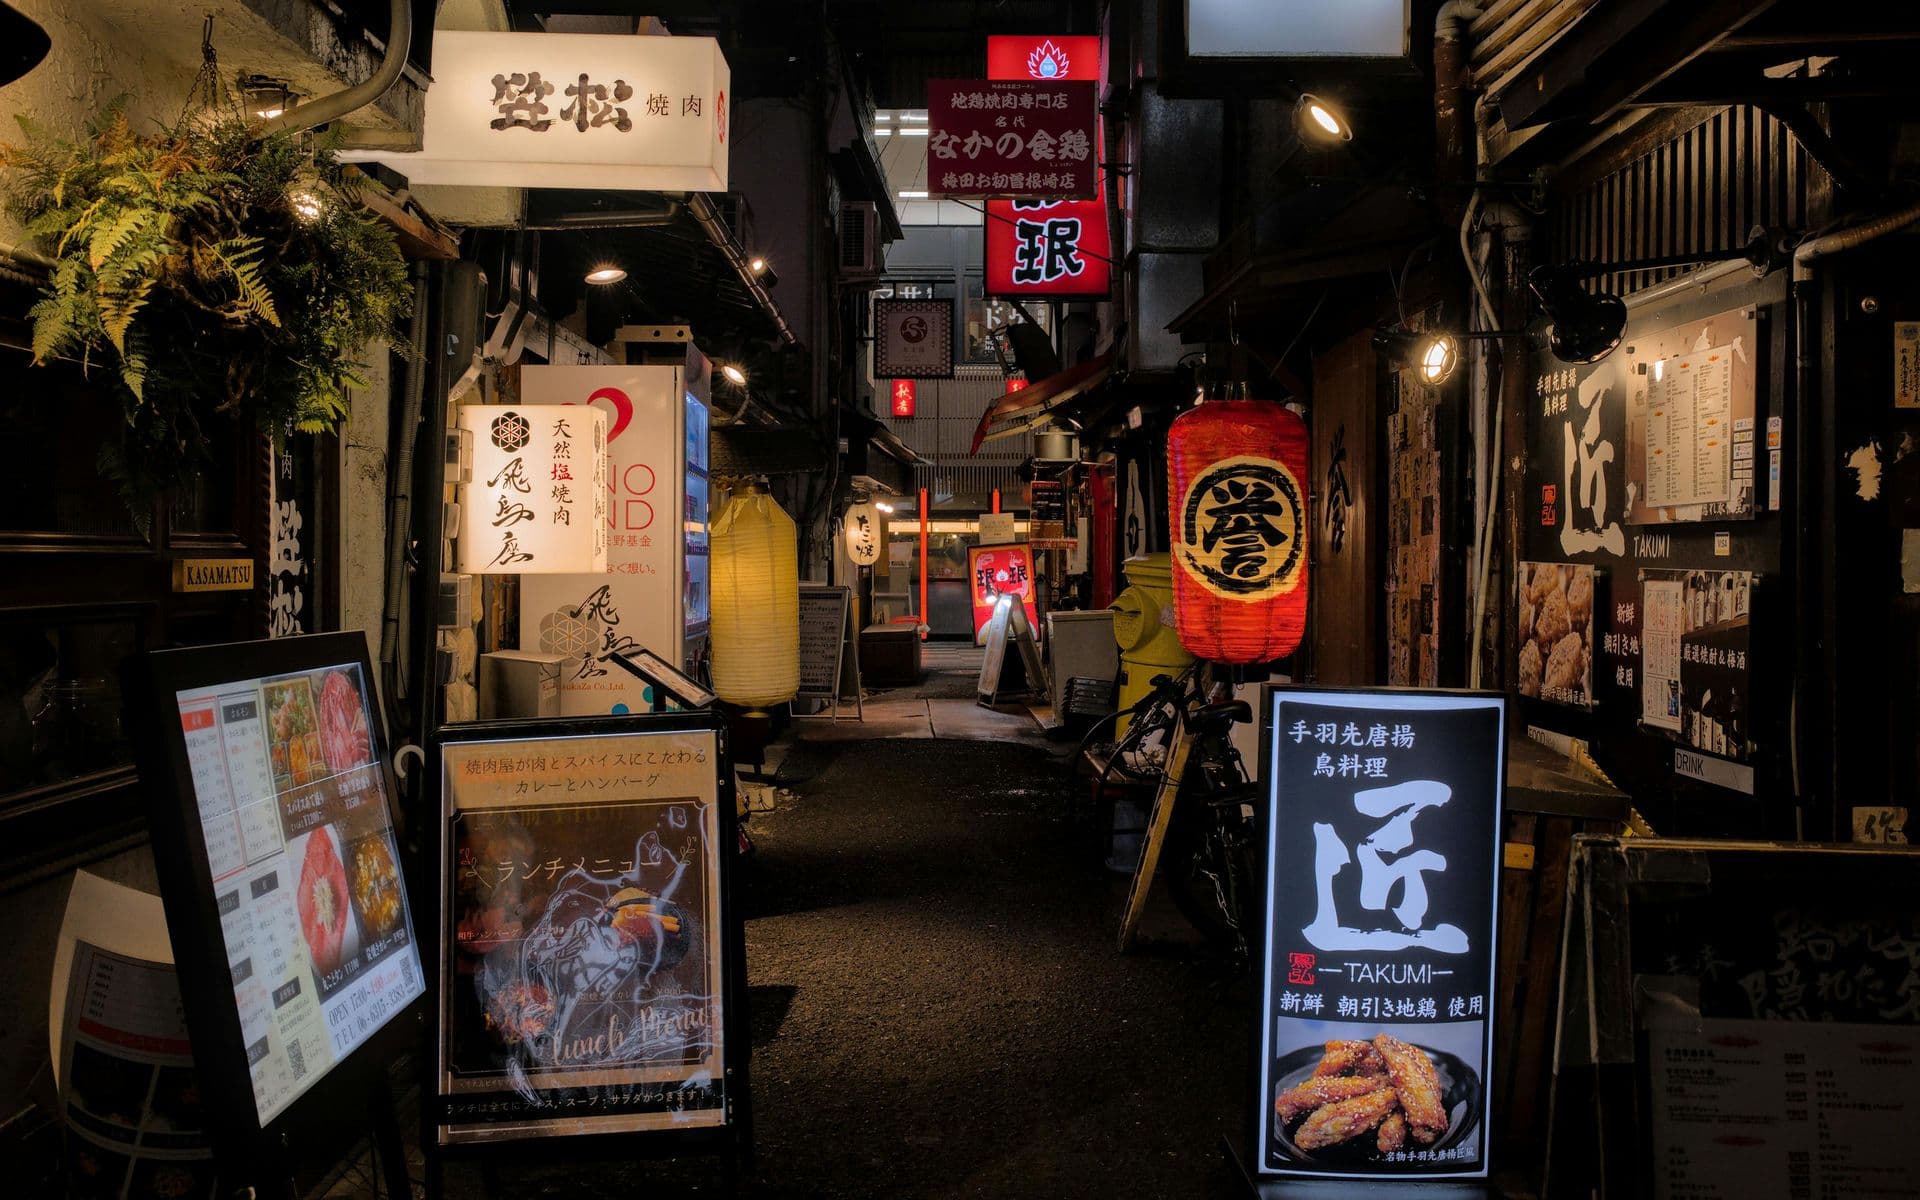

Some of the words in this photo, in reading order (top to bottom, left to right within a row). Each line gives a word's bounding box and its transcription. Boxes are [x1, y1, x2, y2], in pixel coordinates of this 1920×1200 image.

[490, 71, 634, 132] 笠松
[646, 94, 702, 117] 焼肉
[995, 115, 1026, 128] 名代
[930, 129, 1090, 161] なかの食鶏
[1012, 199, 1086, 284] 珉
[1537, 368, 1577, 396] 手羽先唐揚
[1544, 393, 1568, 417] 鳥料理
[551, 418, 573, 527] 天然塩焼肉
[1560, 362, 1625, 557] 匠
[856, 515, 875, 558] たこ焼
[1633, 534, 1670, 558] TAKUMI
[187, 566, 251, 585] KASAMATSU
[1615, 666, 1634, 689] 使用
[1288, 720, 1416, 749] 手羽先唐揚
[465, 749, 707, 775] 焼肉屋が肉とスパイスにこだわる
[1313, 752, 1389, 778] 鳥料理
[1676, 751, 1705, 777] DRINK
[515, 773, 661, 795] カレーとハンバーグ
[497, 856, 663, 883] ランチメニュー
[1302, 780, 1470, 954] 匠
[1343, 962, 1432, 984] TAKUMI
[1280, 990, 1324, 1016] 新鮮
[1336, 994, 1437, 1019] 朝引き地鶏
[1448, 994, 1484, 1017] 使用
[553, 1013, 626, 1066] Lunch
[639, 1005, 708, 1042] Menu
